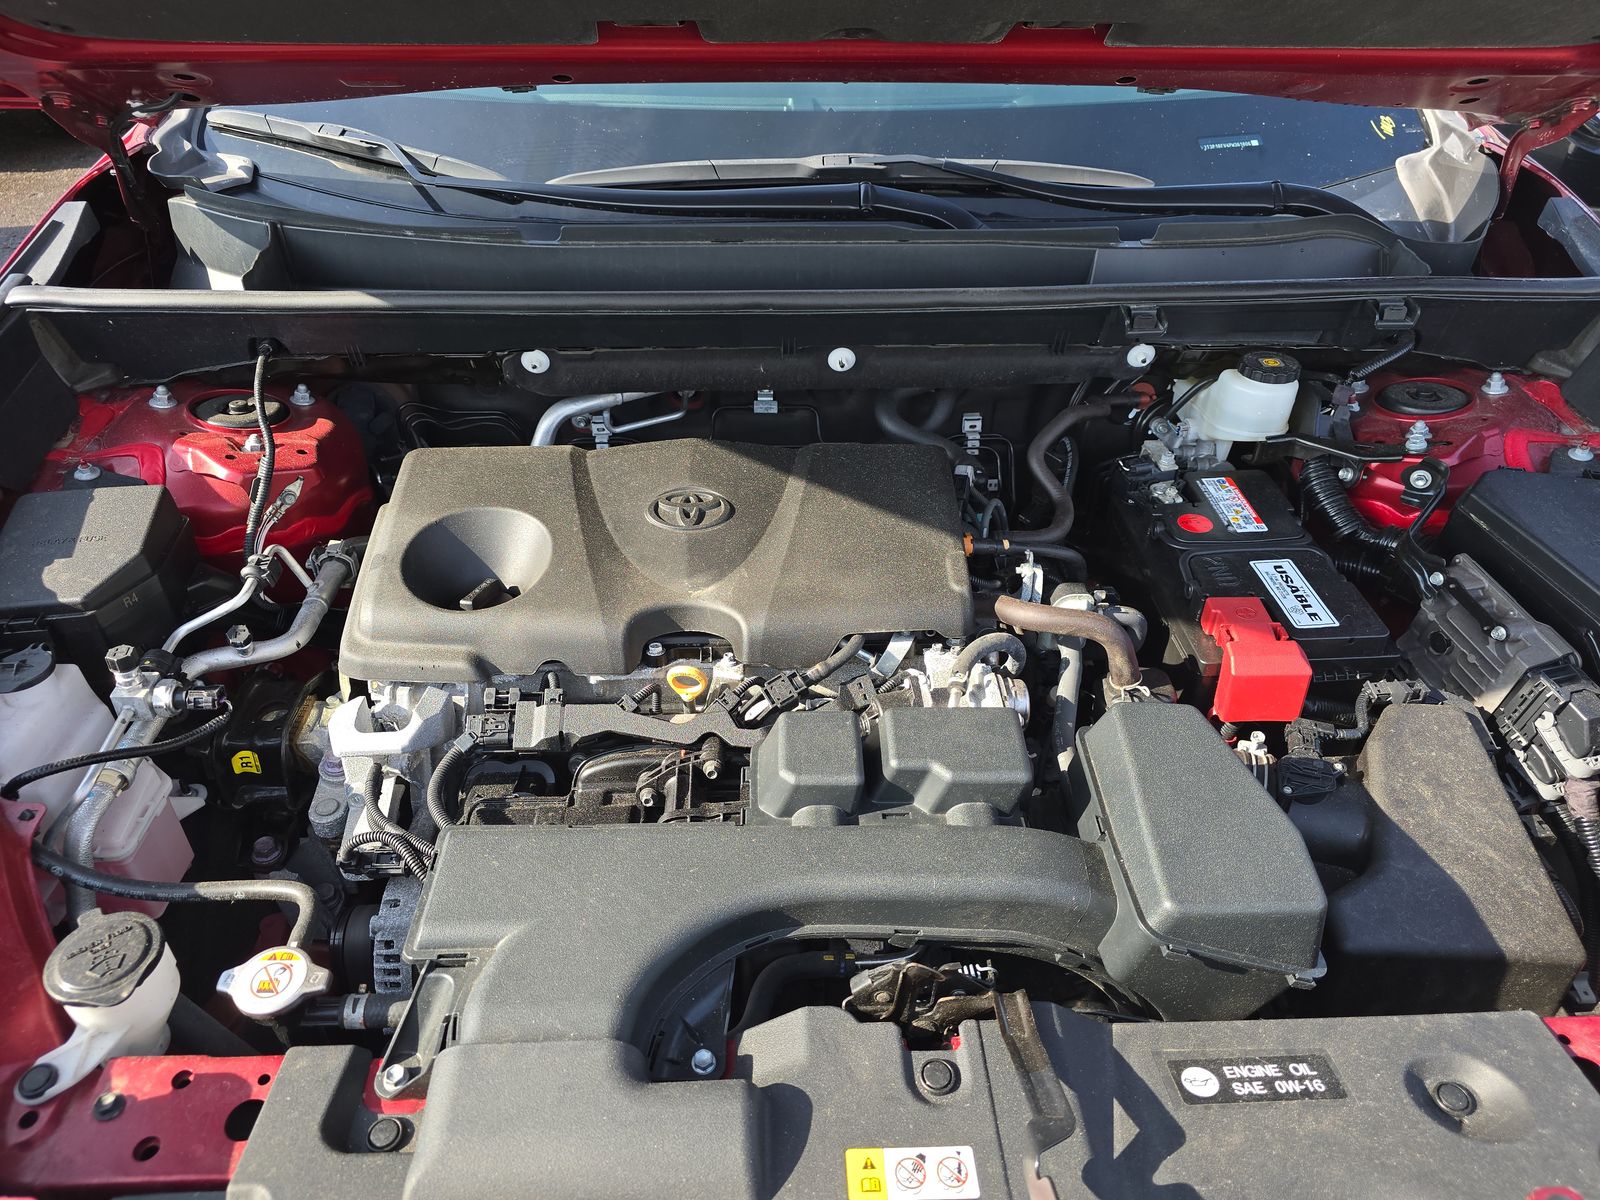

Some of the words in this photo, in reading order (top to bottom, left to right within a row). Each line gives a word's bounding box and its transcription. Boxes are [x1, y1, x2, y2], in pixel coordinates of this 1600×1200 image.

[123, 592, 140, 609] R4
[1273, 564, 1323, 623] USABLE
[239, 756, 254, 769] R1
[1222, 1064, 1283, 1079] ENGINE
[1288, 1063, 1318, 1076] OIL
[1231, 1081, 1268, 1096] SAE
[1274, 1079, 1326, 1093] 0W-16
